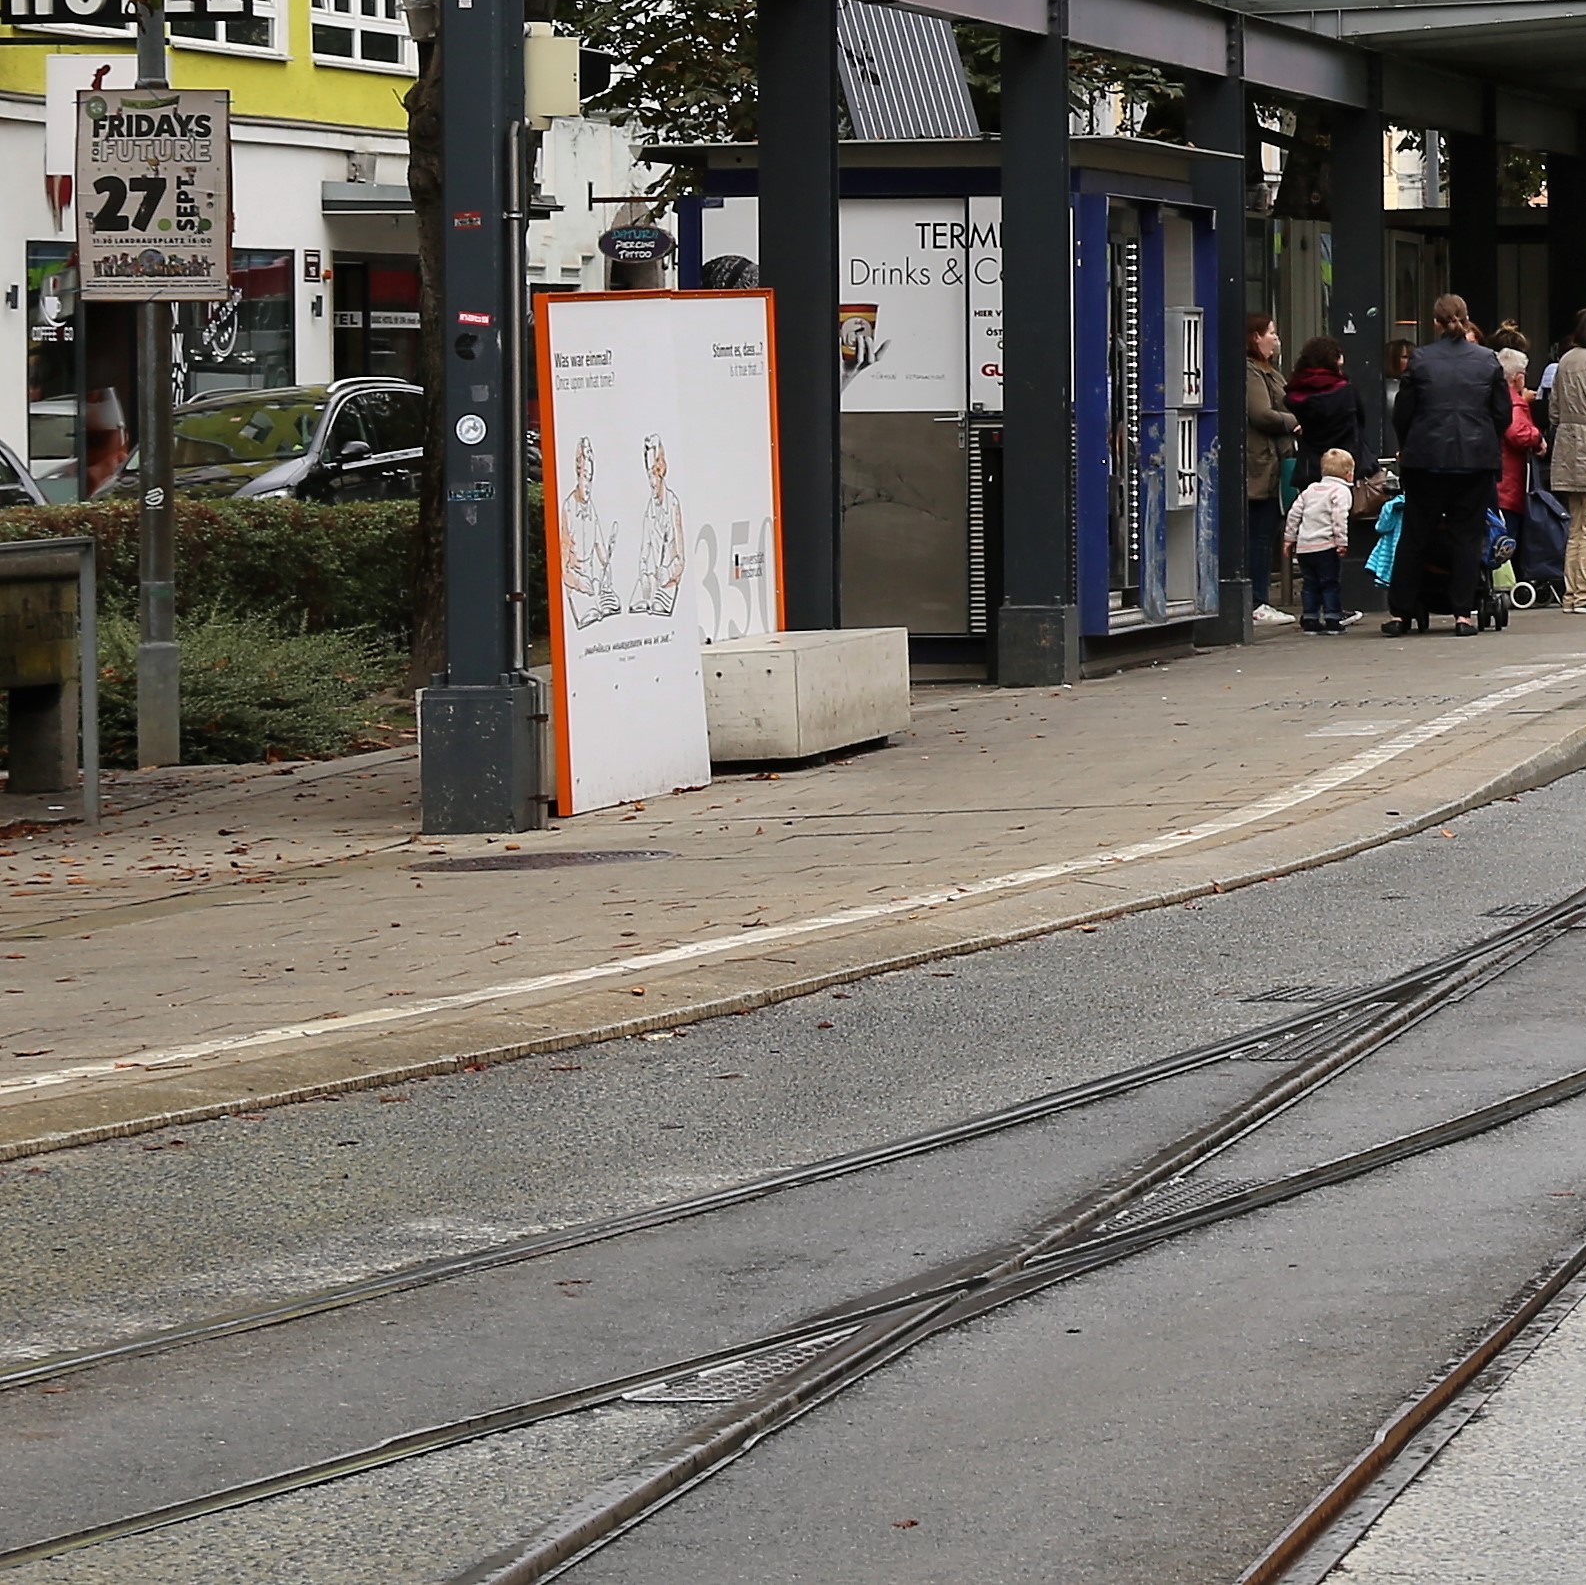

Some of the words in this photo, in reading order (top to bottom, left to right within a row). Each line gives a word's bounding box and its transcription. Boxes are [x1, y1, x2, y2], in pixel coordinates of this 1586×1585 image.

[91, 114, 213, 139] FRIDAYS
[101, 138, 213, 163] FUTURE
[114, 237, 184, 245] LANDHAUSPLATZ
[618, 250, 652, 260] TATTOO
[850, 256, 932, 286] Drinks
[941, 257, 964, 286] &
[974, 257, 1003, 285] C
[974, 309, 994, 318] HIER
[554, 352, 570, 368] Was
[571, 355, 584, 367] war
[585, 349, 612, 367] einmal?
[713, 343, 733, 358] Stimmt
